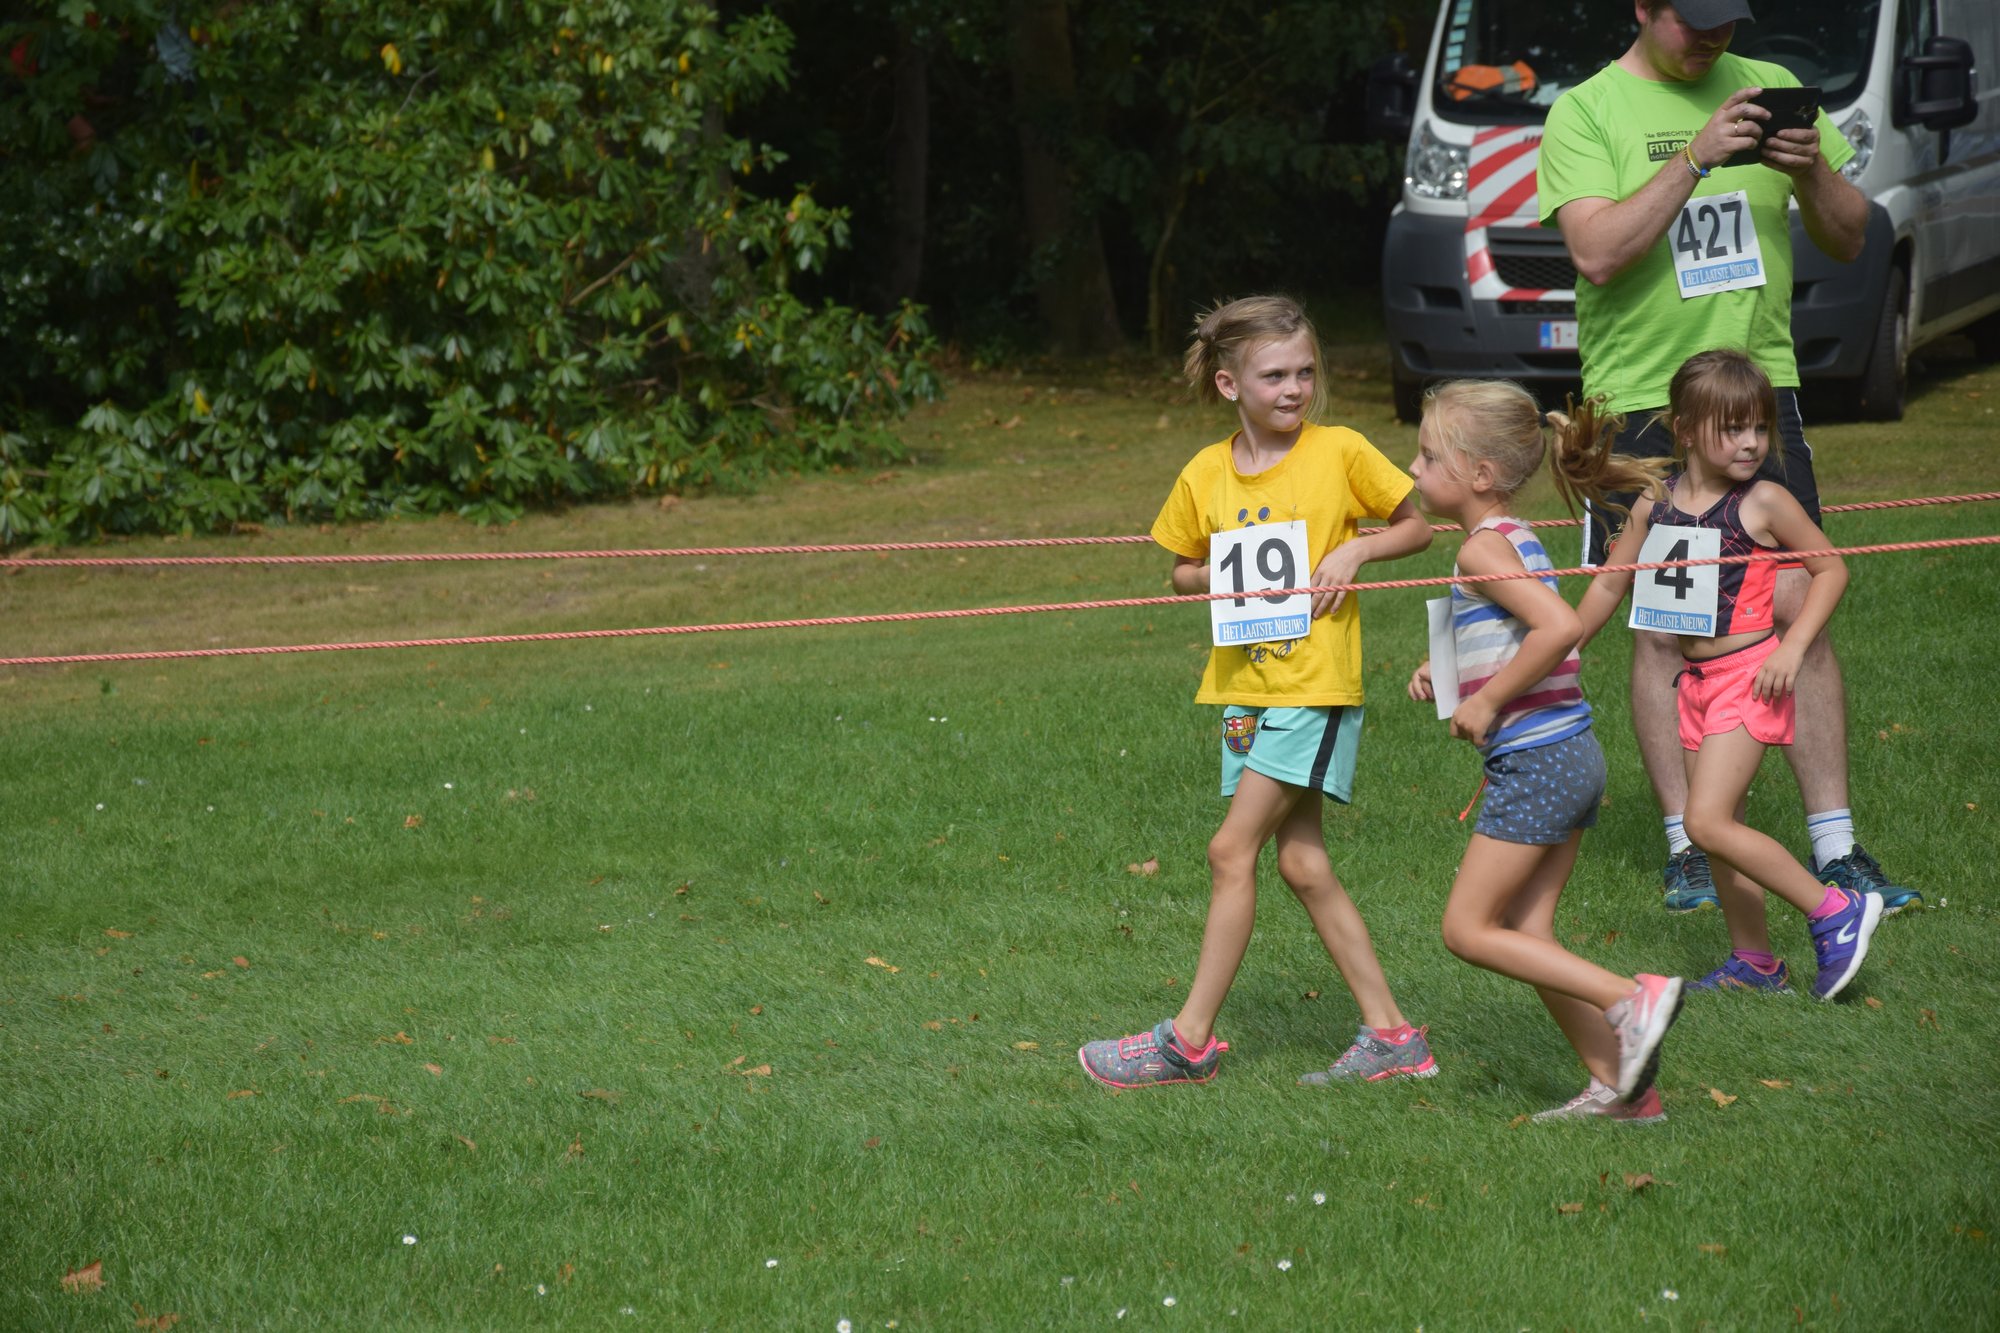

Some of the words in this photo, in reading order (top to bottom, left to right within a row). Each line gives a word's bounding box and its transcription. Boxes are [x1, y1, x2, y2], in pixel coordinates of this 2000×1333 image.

[1656, 130, 1694, 138] BRECHTSE
[1677, 200, 1743, 261] 427
[1684, 271, 1699, 286] HET
[1700, 266, 1729, 283] LAATSTE
[1729, 262, 1757, 278] NIEUWS
[1220, 537, 1296, 608] 19
[1654, 539, 1694, 600] 4
[1222, 624, 1239, 641] HET
[1239, 621, 1274, 640] LAATSTE
[1274, 617, 1305, 636] NIEUWS
[1638, 608, 1651, 625] HET
[1651, 611, 1680, 629] LAATSTE
[1680, 613, 1709, 632] NIEUWS
